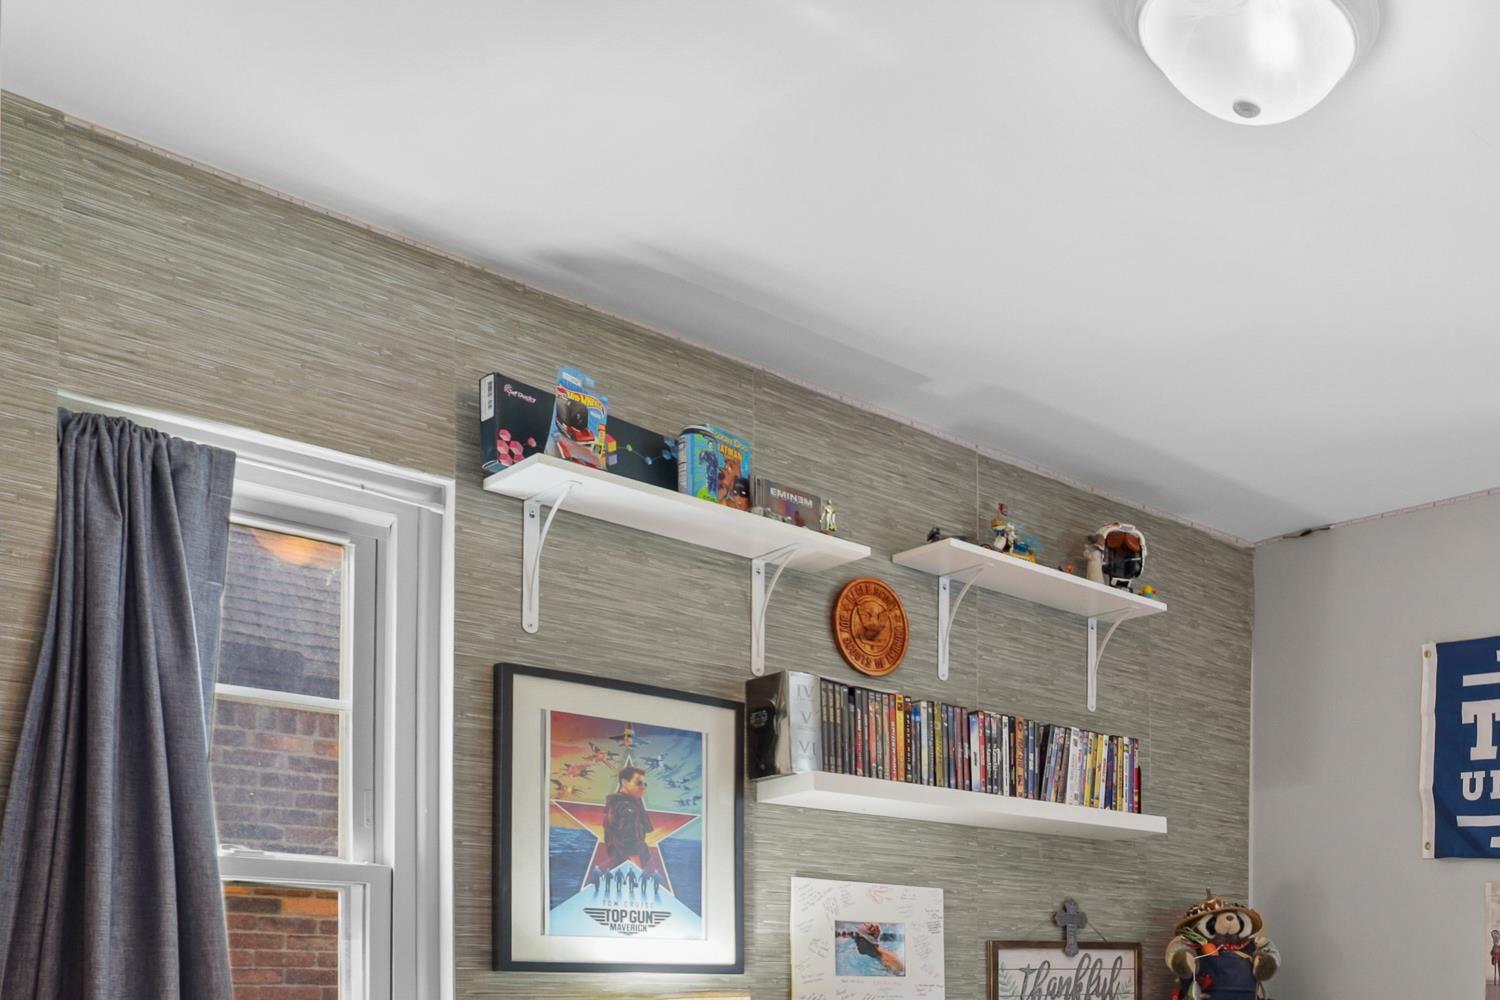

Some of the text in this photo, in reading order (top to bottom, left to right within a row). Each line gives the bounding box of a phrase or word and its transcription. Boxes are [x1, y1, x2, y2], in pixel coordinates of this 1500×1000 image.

[606, 908, 653, 924] TOP GUN
[610, 922, 648, 932] MAVERICK
